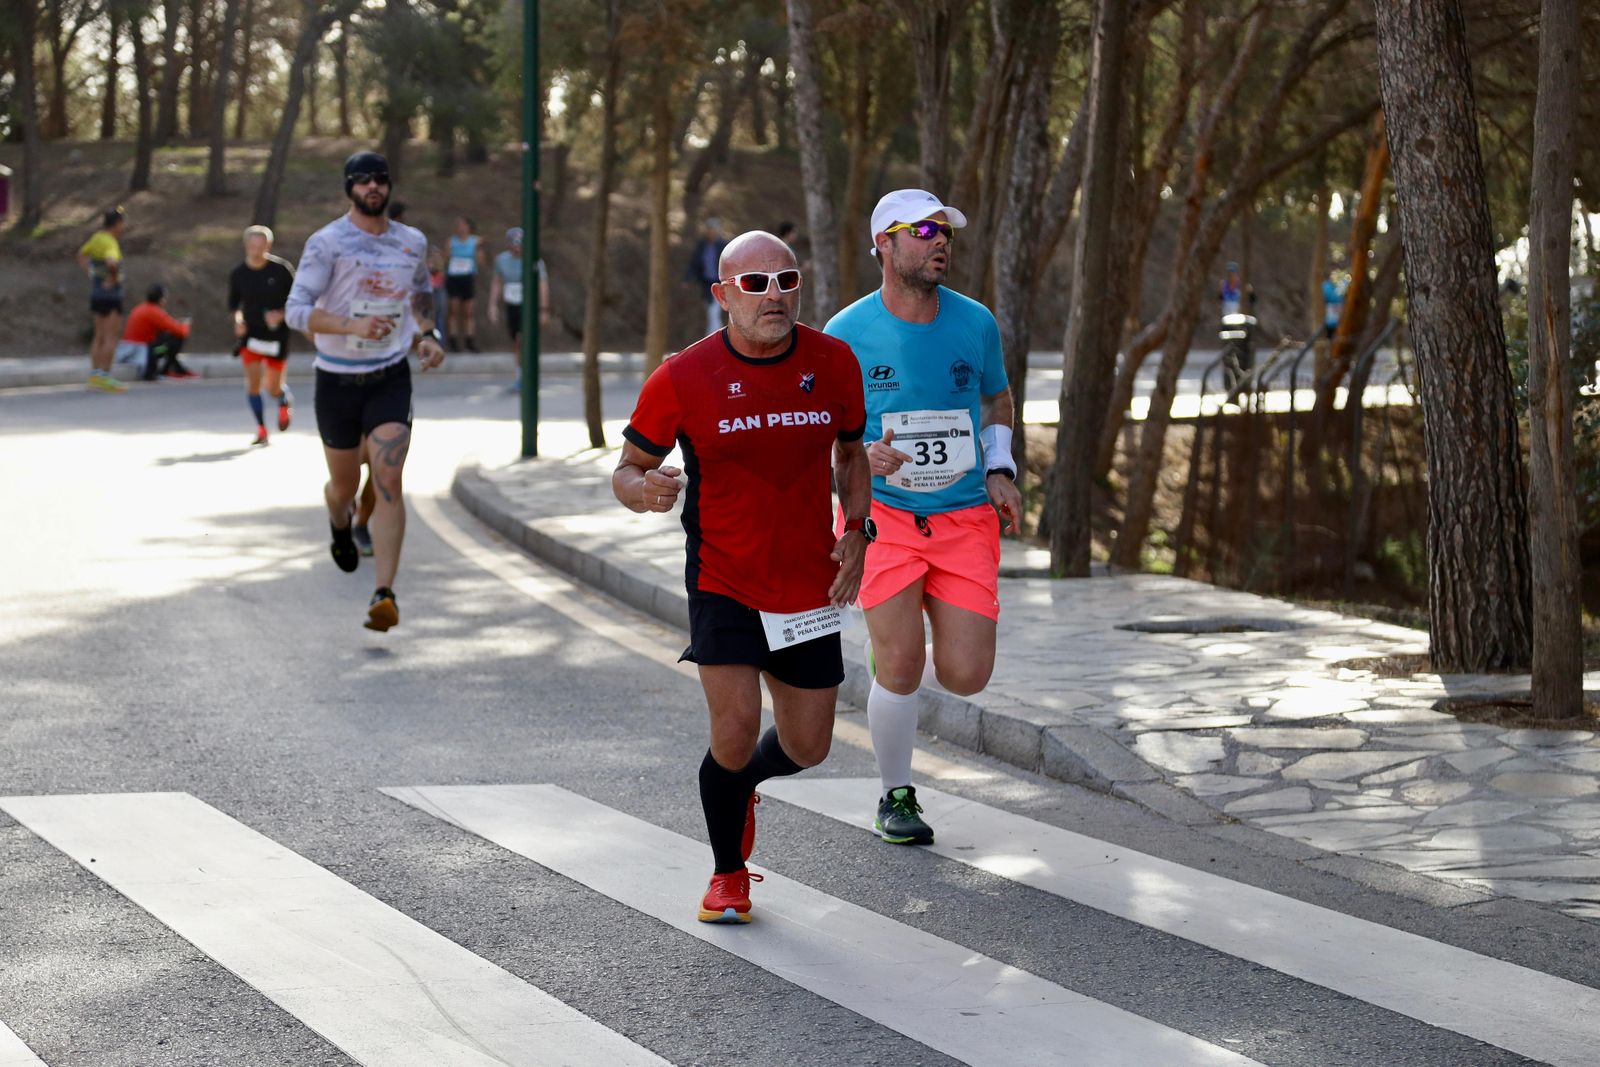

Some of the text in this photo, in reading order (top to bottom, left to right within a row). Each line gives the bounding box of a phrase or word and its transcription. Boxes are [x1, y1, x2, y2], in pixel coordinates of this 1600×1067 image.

[868, 381, 900, 389] HYUNDAI
[718, 411, 831, 433] SAN PEDRO
[914, 440, 948, 466] 33
[803, 618, 816, 626] MINI
[816, 612, 840, 622] MARATÓN
[797, 628, 813, 636] PEÑA
[821, 620, 841, 629] BASTÓN
